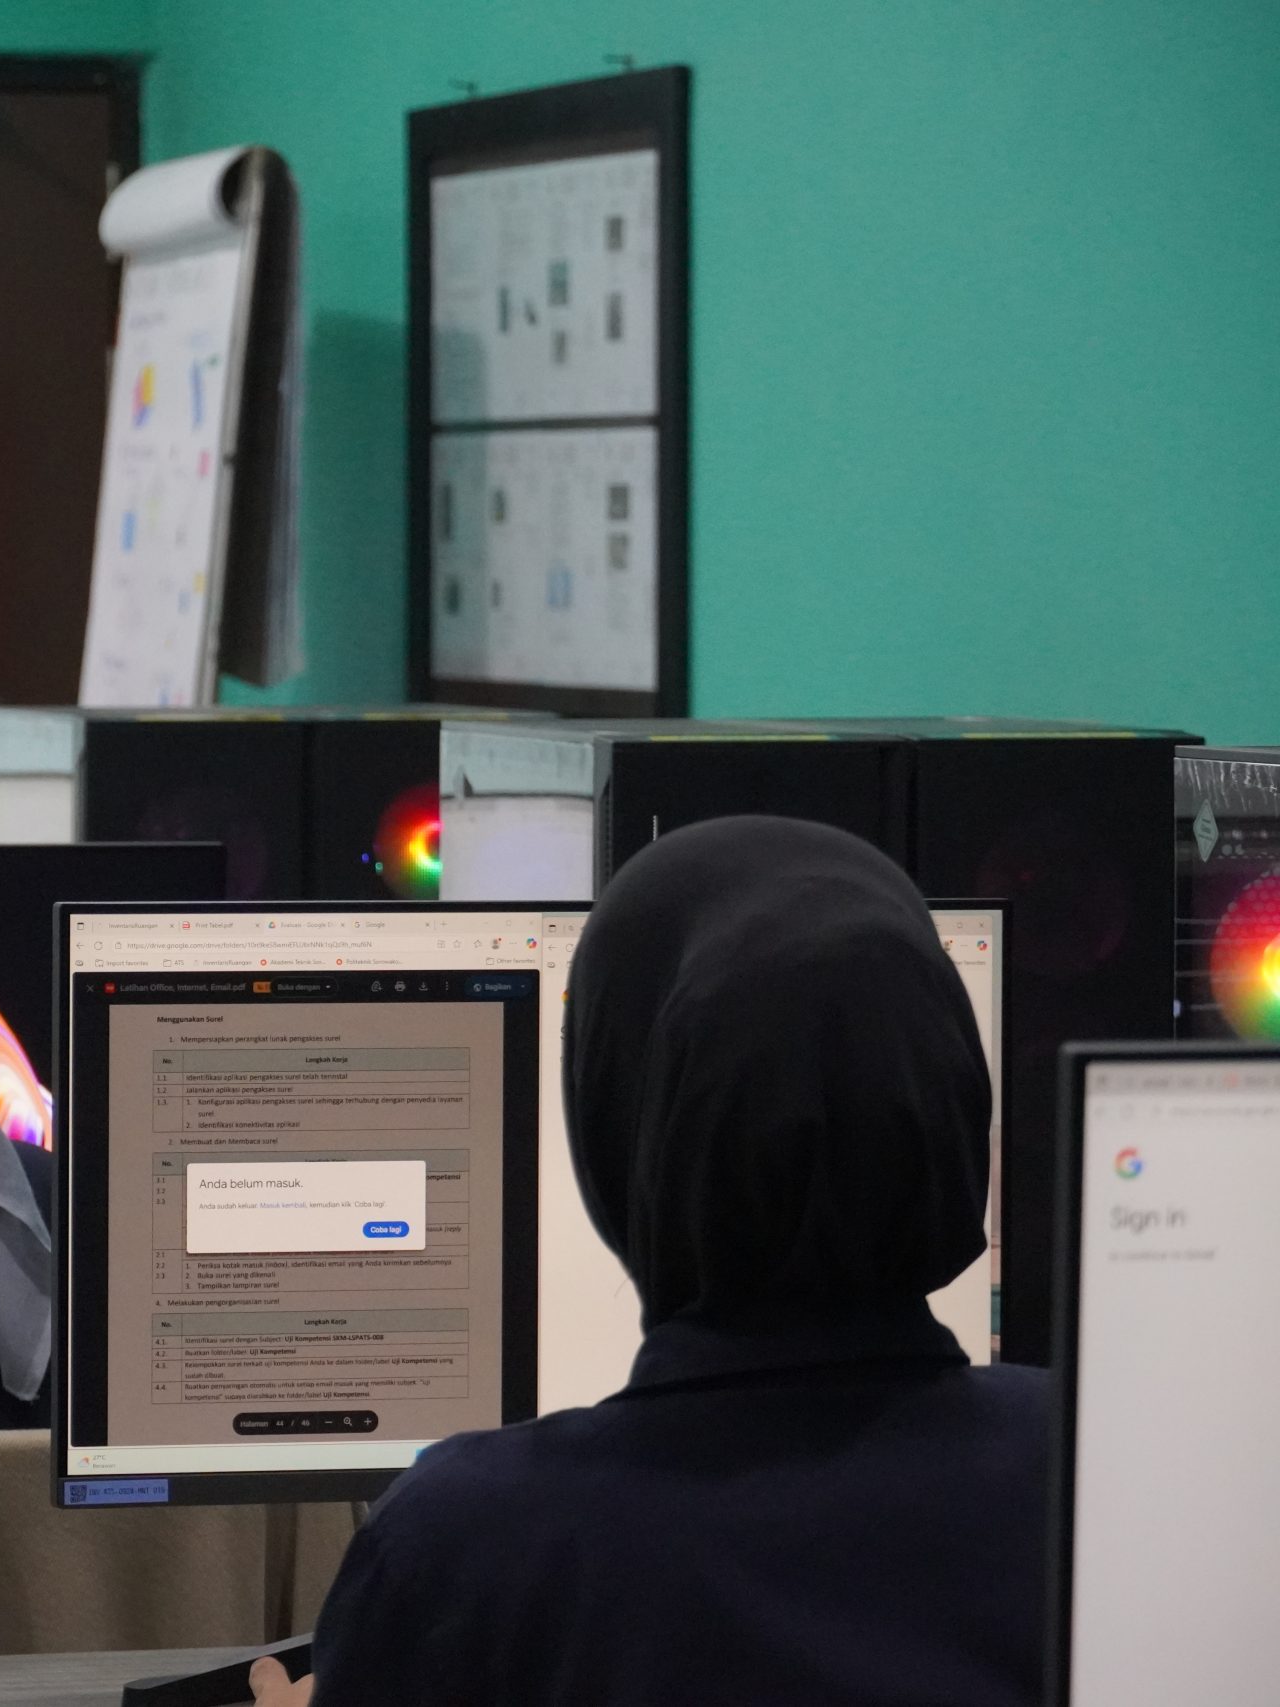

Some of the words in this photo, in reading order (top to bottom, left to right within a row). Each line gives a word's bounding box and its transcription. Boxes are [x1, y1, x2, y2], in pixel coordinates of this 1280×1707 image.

[365, 921, 386, 930] Google
[120, 983, 149, 992] Latihan
[150, 983, 175, 993] Office,
[177, 983, 208, 992] Internet,
[210, 982, 245, 993] Email.pdf
[277, 983, 294, 992] Buka
[295, 983, 321, 993] dengan
[485, 982, 511, 992] Bagikan
[156, 1015, 205, 1025] Menggunakan
[206, 1014, 224, 1023] Surel
[181, 1036, 234, 1046] Mempersiapkan
[235, 1035, 269, 1045] perangkat
[269, 1034, 288, 1043] lunak
[289, 1034, 324, 1044] pengakses
[325, 1034, 341, 1042] surel
[305, 1055, 331, 1065] Langkah
[332, 1055, 348, 1065] Kerja
[186, 1073, 222, 1082] Identifikasi
[223, 1073, 248, 1084] aplikasi
[249, 1073, 284, 1084] pengakses
[285, 1073, 301, 1081] surel
[302, 1072, 320, 1081] telah
[186, 1086, 215, 1095] Jalankan
[216, 1086, 240, 1096] aplikasi
[241, 1086, 276, 1096] pengakses
[277, 1085, 294, 1094] surel
[198, 1098, 235, 1108] Konfigurasi
[236, 1098, 261, 1108] aplikasi
[262, 1098, 296, 1107] pengakses
[297, 1097, 314, 1105] surel
[315, 1097, 344, 1107] sehingga
[345, 1096, 380, 1106] terhubung
[381, 1096, 405, 1106] dengan
[406, 1096, 437, 1106] penyedia
[438, 1096, 464, 1105] layanan
[198, 1110, 216, 1118] surel
[198, 1121, 234, 1130] Identifikasi
[235, 1121, 275, 1130] konektivitas
[276, 1121, 301, 1131] aplikasi
[180, 1138, 212, 1146] Membuat
[214, 1138, 227, 1146] dan
[228, 1137, 261, 1146] Membaca
[262, 1137, 279, 1145] surel
[199, 1178, 228, 1190] Anda
[229, 1177, 264, 1190] belum
[265, 1177, 304, 1189] masuk.
[426, 1173, 461, 1183] ompetensi
[199, 1202, 216, 1210] Anda
[217, 1202, 237, 1210] sudah
[260, 1201, 281, 1210] Masuk
[309, 1200, 340, 1209] kemudian
[341, 1200, 351, 1208] klik
[1110, 1205, 1160, 1235] Sign
[1166, 1206, 1188, 1229] in
[370, 1225, 389, 1235] Coba
[389, 1224, 402, 1236] lagi
[198, 1262, 222, 1271] Periksa
[222, 1262, 241, 1270] kotak
[242, 1262, 264, 1270] masuk
[291, 1260, 327, 1270] identifikasi
[328, 1260, 346, 1269] email
[347, 1260, 364, 1270] yang
[364, 1260, 382, 1268] Anda
[383, 1259, 412, 1268] kirimkan
[412, 1258, 452, 1268] sebelumnya
[197, 1272, 214, 1280] Buka
[215, 1272, 232, 1280] surel
[232, 1273, 249, 1282] yang
[249, 1271, 276, 1280] dikenali
[197, 1282, 231, 1292] Tampilkan
[232, 1282, 262, 1291] lampiran
[263, 1281, 280, 1290] surel
[168, 1299, 204, 1308] Melakukan
[205, 1298, 262, 1308] pengorganisasian
[263, 1298, 280, 1307] surel
[304, 1319, 330, 1329] Langkah
[331, 1318, 348, 1328] Kerja
[185, 1337, 218, 1346] Identifikasi
[219, 1337, 235, 1345] surel
[236, 1337, 259, 1346] dengan
[284, 1335, 294, 1345] Uji
[295, 1334, 332, 1345] Kompetensi
[185, 1349, 210, 1358] Buatkan
[249, 1348, 260, 1358] Uji
[260, 1347, 297, 1357] Kompetensi
[185, 1361, 226, 1371] Kelompokkan
[227, 1361, 243, 1369] surel
[243, 1360, 264, 1369] terkait
[264, 1360, 272, 1369] uji
[273, 1359, 309, 1369] kompetensi
[309, 1359, 326, 1367] Anda
[335, 1358, 354, 1367] dalam
[391, 1358, 401, 1367] Uji
[401, 1357, 438, 1367] Kompetensi
[439, 1357, 455, 1366] yang
[185, 1372, 204, 1380] sudah
[185, 1383, 210, 1392] Buatkan
[249, 1382, 277, 1391] otomatis
[277, 1382, 296, 1390] untuk
[296, 1381, 315, 1391] setiap
[315, 1380, 333, 1388] email
[334, 1380, 354, 1388] masuk
[354, 1380, 369, 1389] yang
[370, 1379, 396, 1387] memiliki
[224, 1392, 247, 1402] supaya
[247, 1391, 277, 1401] diarahkan
[323, 1390, 332, 1400] Uji
[275, 1420, 285, 1429] 44
